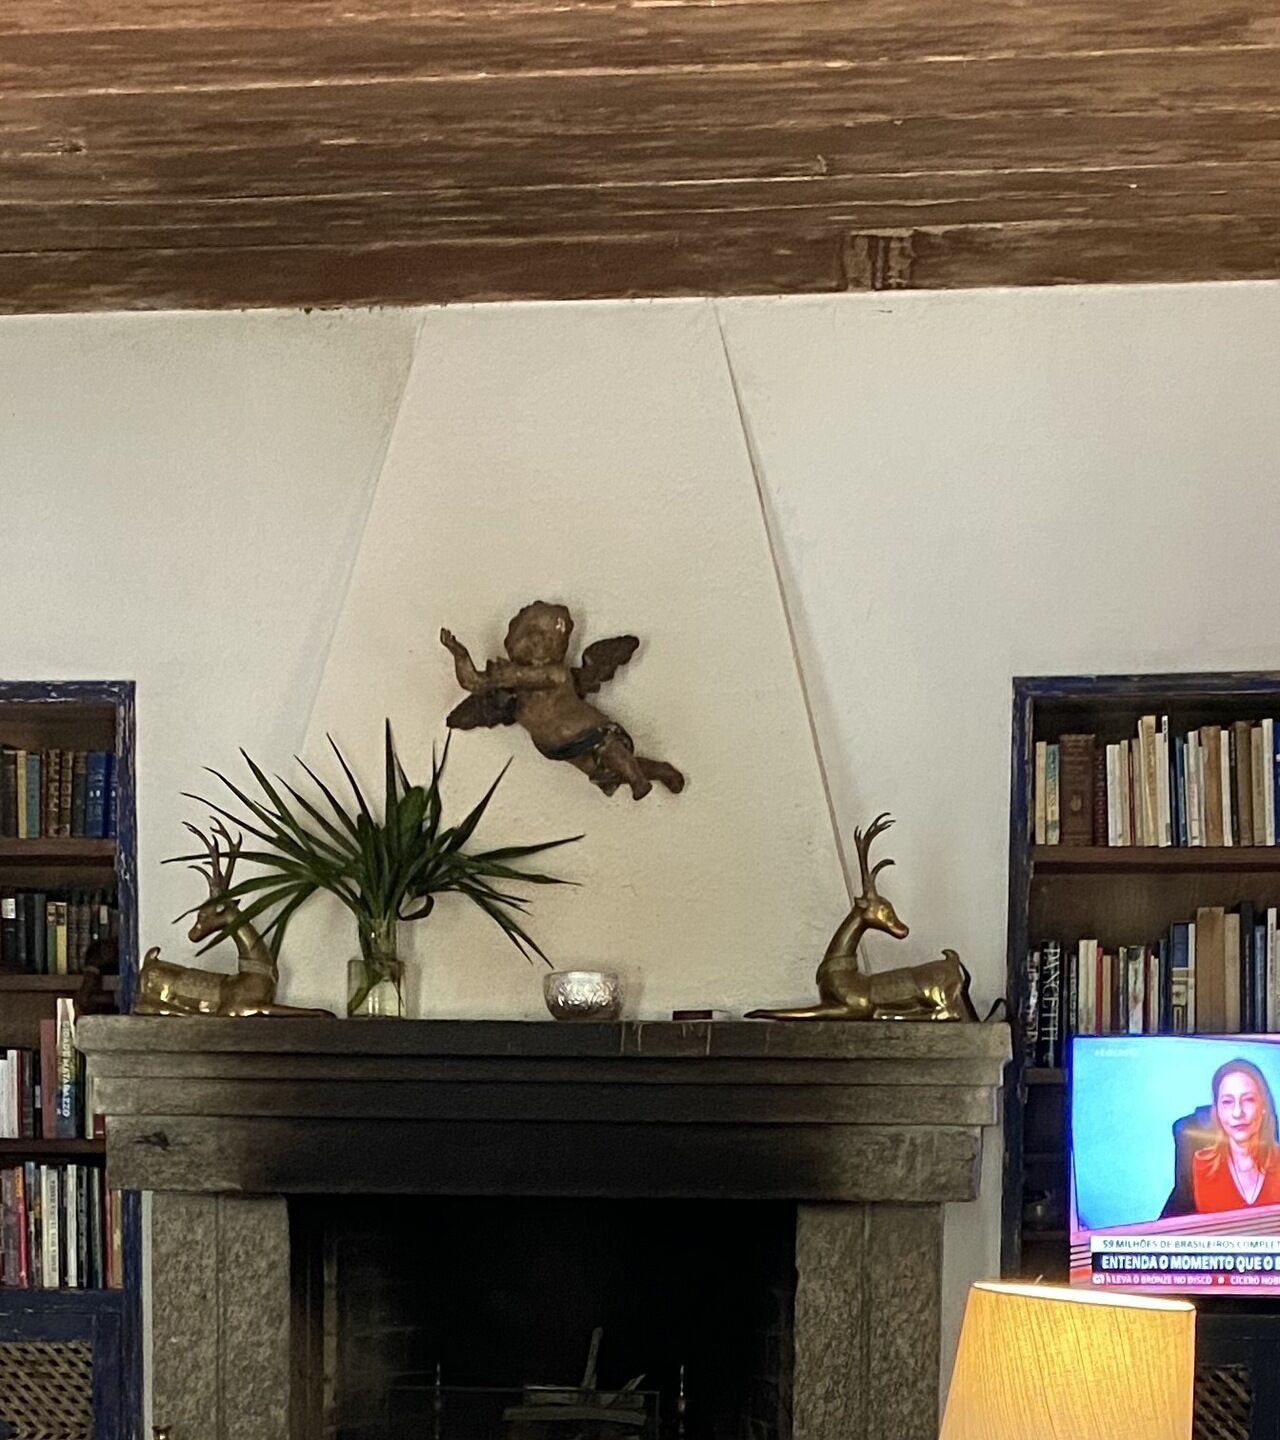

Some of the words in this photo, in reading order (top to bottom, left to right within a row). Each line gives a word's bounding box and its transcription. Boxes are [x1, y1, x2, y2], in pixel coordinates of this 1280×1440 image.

[1041, 947, 1061, 1041] PANCETTI
[1103, 1240, 1114, 1249] 59
[1115, 1238, 1158, 1249] MILHÕES
[1160, 1240, 1172, 1249] DE
[1174, 1240, 1234, 1249] BRASILEIROS
[1101, 1255, 1158, 1270] ENTENDA
[1158, 1255, 1169, 1270] O
[1170, 1256, 1234, 1270] MOMENTO
[1235, 1256, 1262, 1273] QUE
[1263, 1256, 1273, 1270] O
